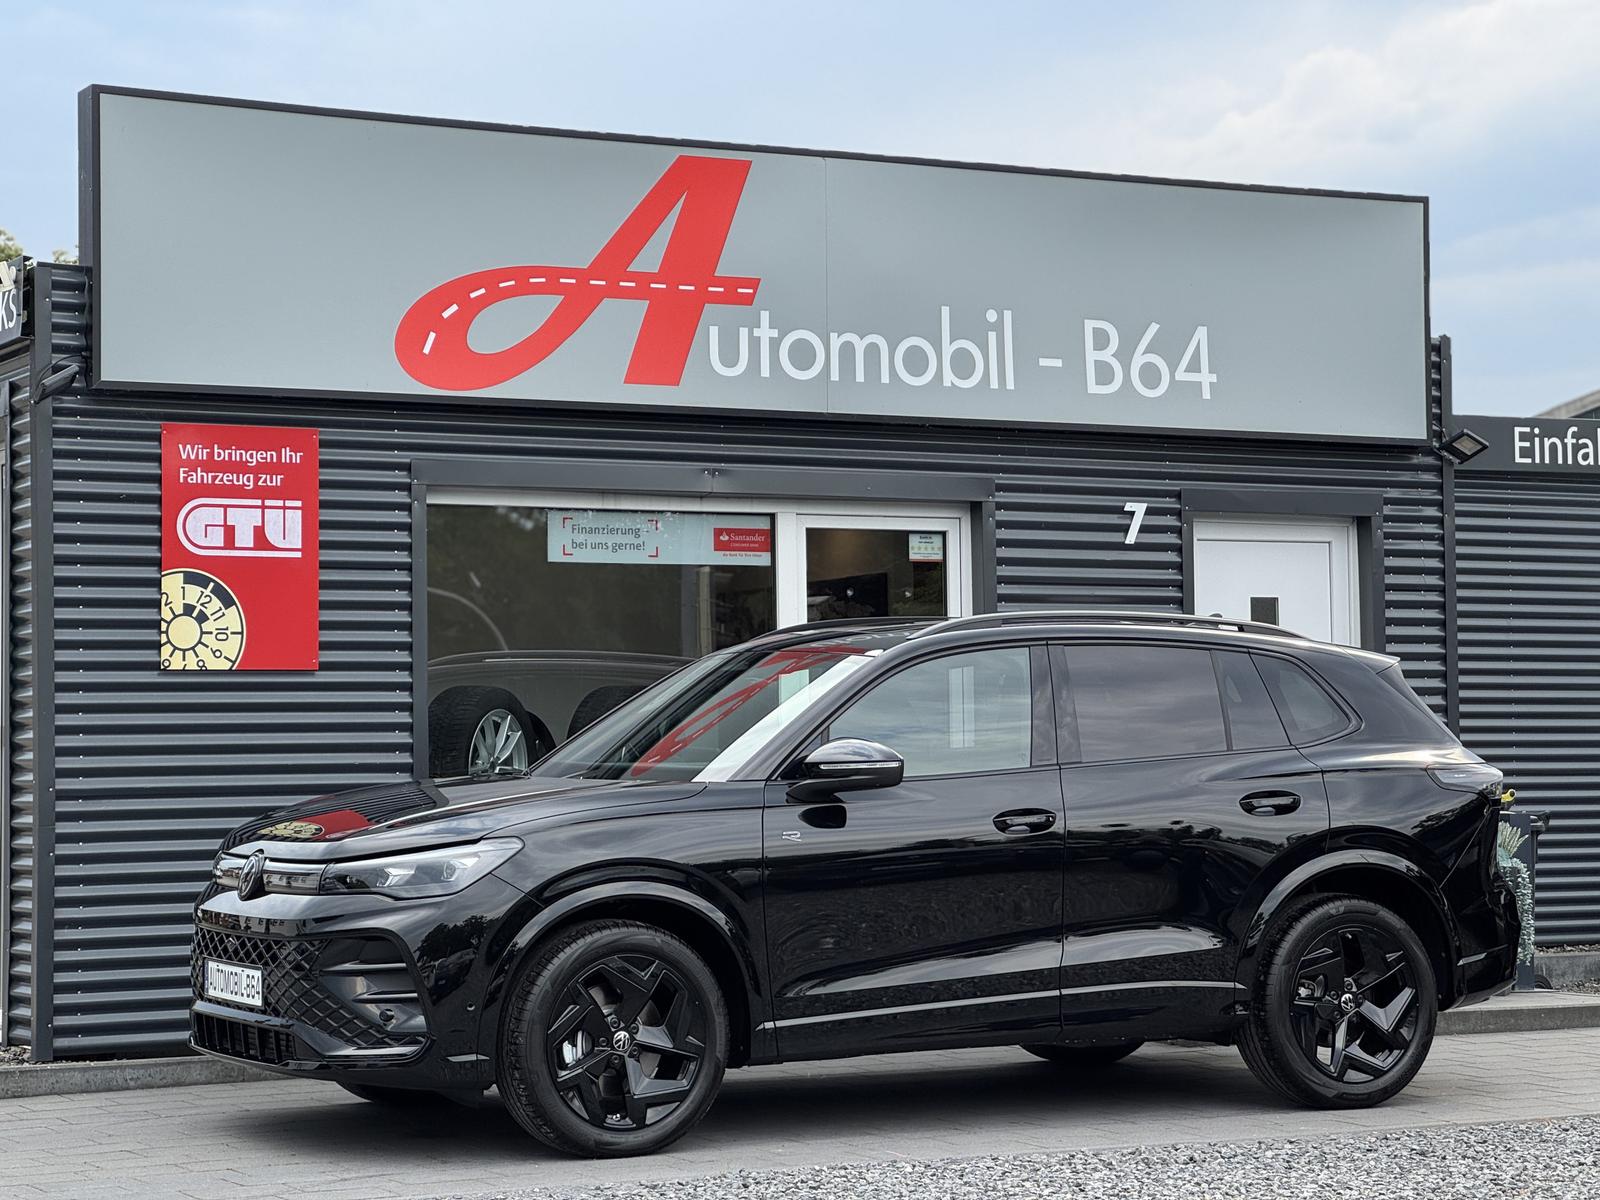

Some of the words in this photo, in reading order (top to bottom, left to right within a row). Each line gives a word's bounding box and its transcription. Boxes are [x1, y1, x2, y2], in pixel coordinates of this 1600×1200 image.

[1083, 319, 1218, 400] B64
[178, 443, 210, 460] Wir
[213, 444, 277, 466] bringen
[281, 447, 303, 464] Ihr
[1513, 426, 1600, 466] Einfa
[179, 467, 254, 490] Fahrzeug
[257, 473, 284, 487] zur
[571, 523, 641, 539] Finanzierung
[1123, 502, 1148, 545] 7
[571, 538, 588, 550] bei
[590, 541, 609, 550] uns
[611, 541, 646, 553] gerne!
[730, 532, 766, 542] Santander
